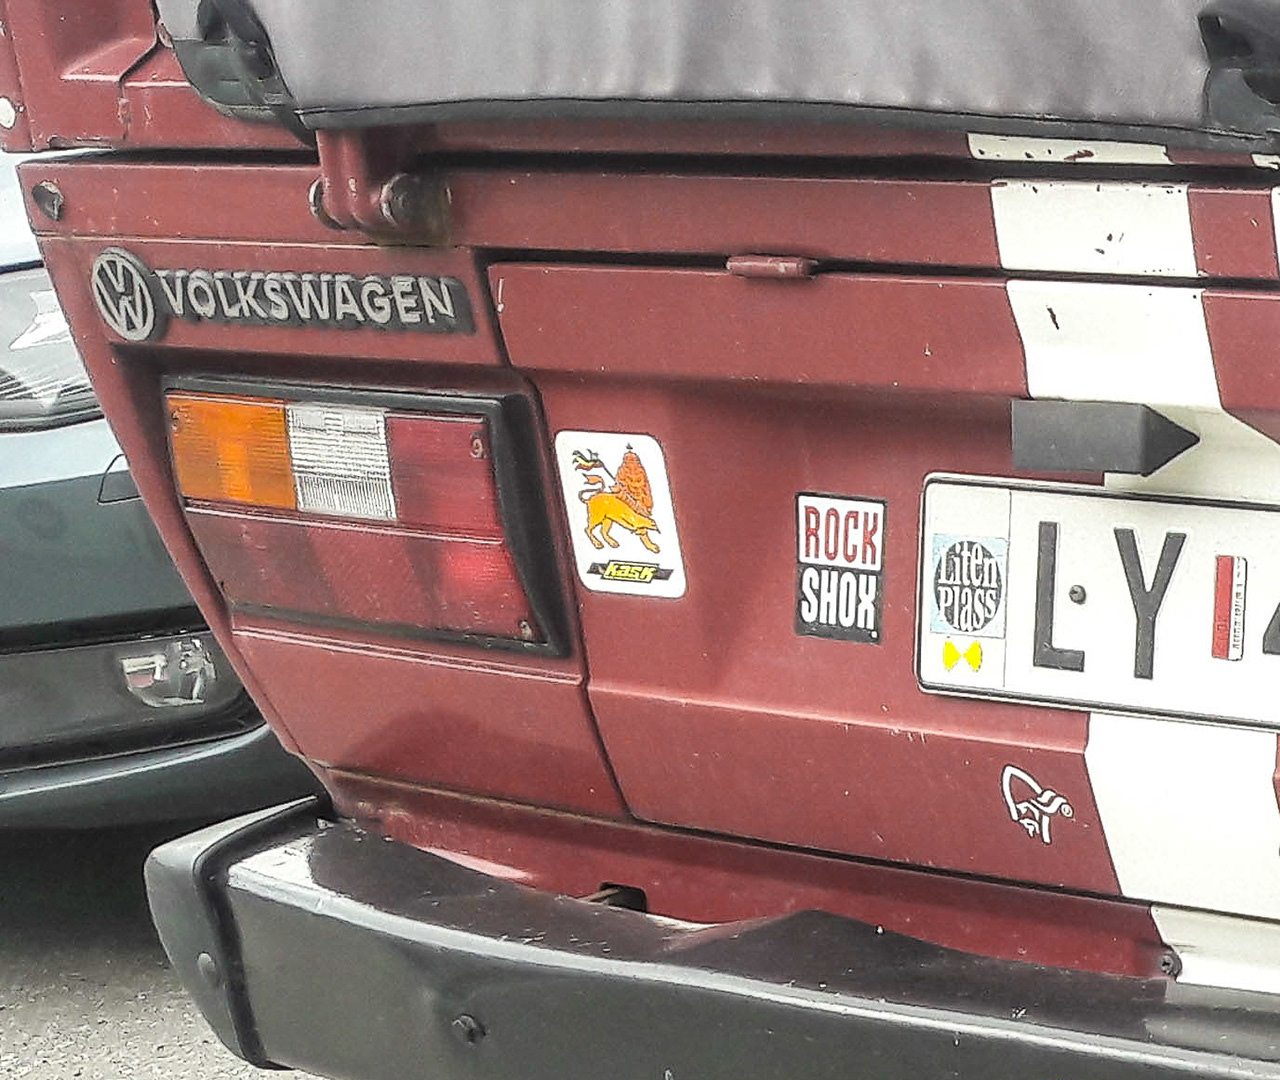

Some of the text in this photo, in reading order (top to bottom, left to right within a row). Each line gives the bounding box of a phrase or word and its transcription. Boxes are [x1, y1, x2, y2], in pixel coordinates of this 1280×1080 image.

[156, 270, 456, 325] VOLKSWAGEN
[804, 505, 878, 565] ROCK
[938, 540, 998, 588] Liten
[801, 567, 876, 630] SHOX
[937, 586, 998, 632] Plass
[1033, 521, 1187, 680] LY
